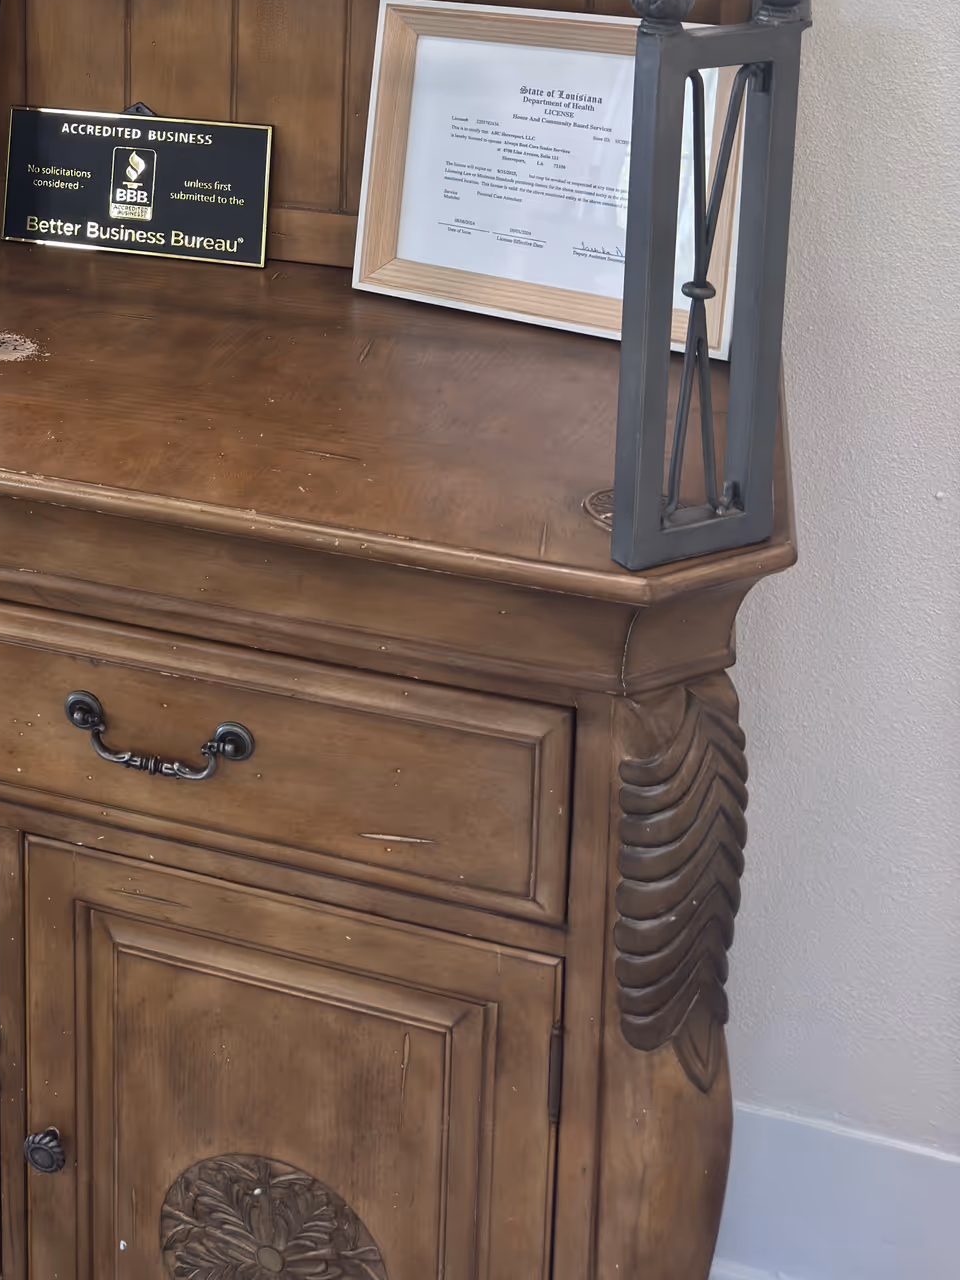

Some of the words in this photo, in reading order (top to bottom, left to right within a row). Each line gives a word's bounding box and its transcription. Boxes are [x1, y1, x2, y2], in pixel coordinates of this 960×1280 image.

[520, 85, 544, 97] State
[546, 89, 555, 98] of
[557, 90, 603, 104] Louisiana
[522, 96, 562, 108] Department
[572, 102, 595, 112] Health
[544, 109, 575, 118] LICENSE
[61, 122, 141, 140] ACCREDITED
[147, 129, 213, 146] BUSINESS
[572, 122, 589, 130] Based
[589, 124, 612, 133] Services
[27, 163, 40, 174] No
[41, 165, 92, 179] solicitations
[33, 178, 80, 190] considered
[184, 179, 213, 190] unless
[214, 180, 232, 192] first
[170, 190, 216, 204] submitted
[217, 195, 227, 204] to
[228, 195, 245, 206] the
[26, 215, 81, 237] Better
[86, 221, 165, 246] Business
